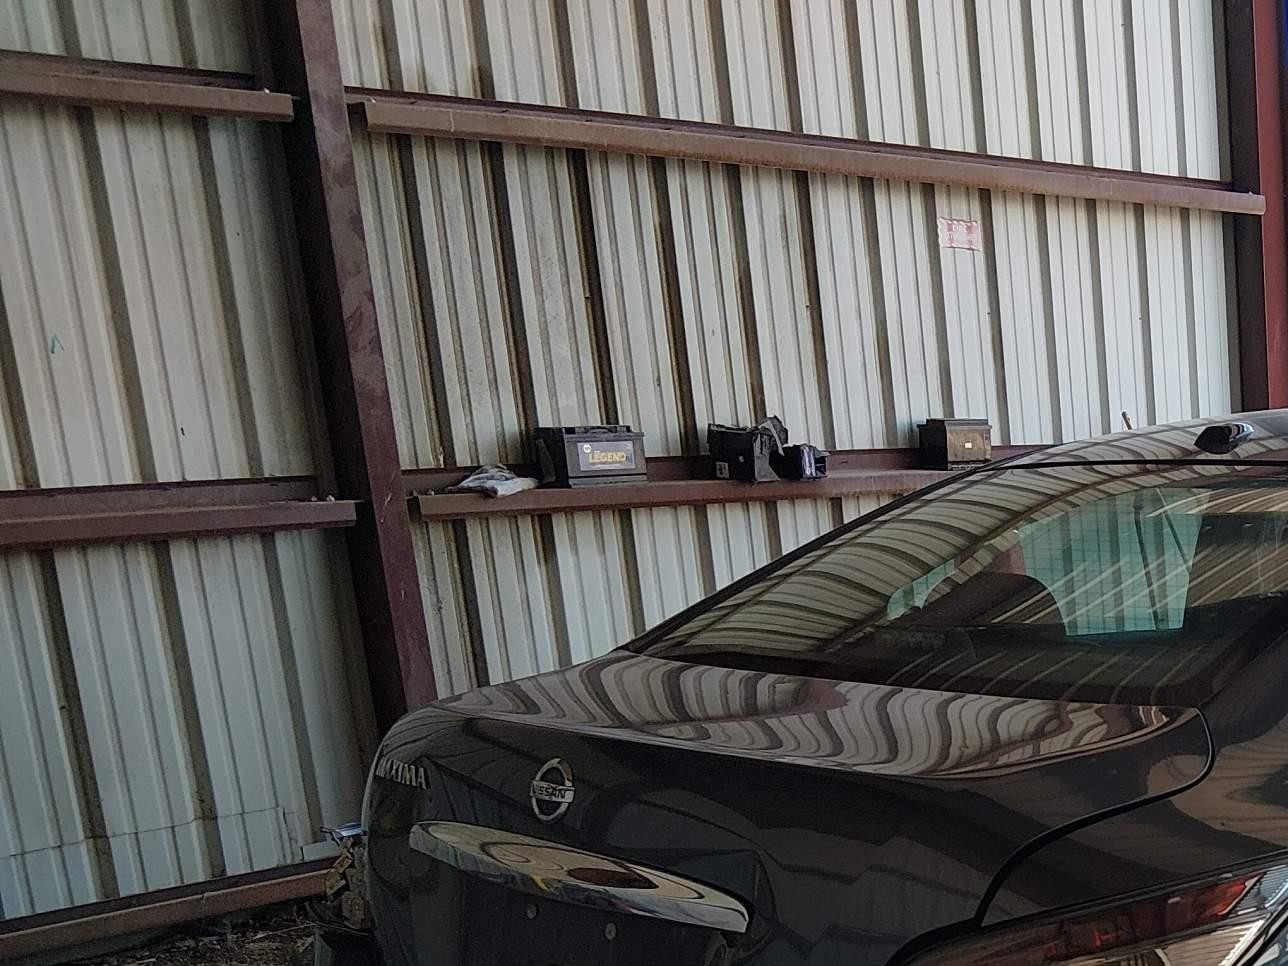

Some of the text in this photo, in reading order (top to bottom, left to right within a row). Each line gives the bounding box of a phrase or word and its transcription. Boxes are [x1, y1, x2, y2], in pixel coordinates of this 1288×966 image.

[589, 451, 627, 464] LEGEND
[375, 757, 427, 790] MAXIMA
[531, 783, 567, 800] NISSAN
